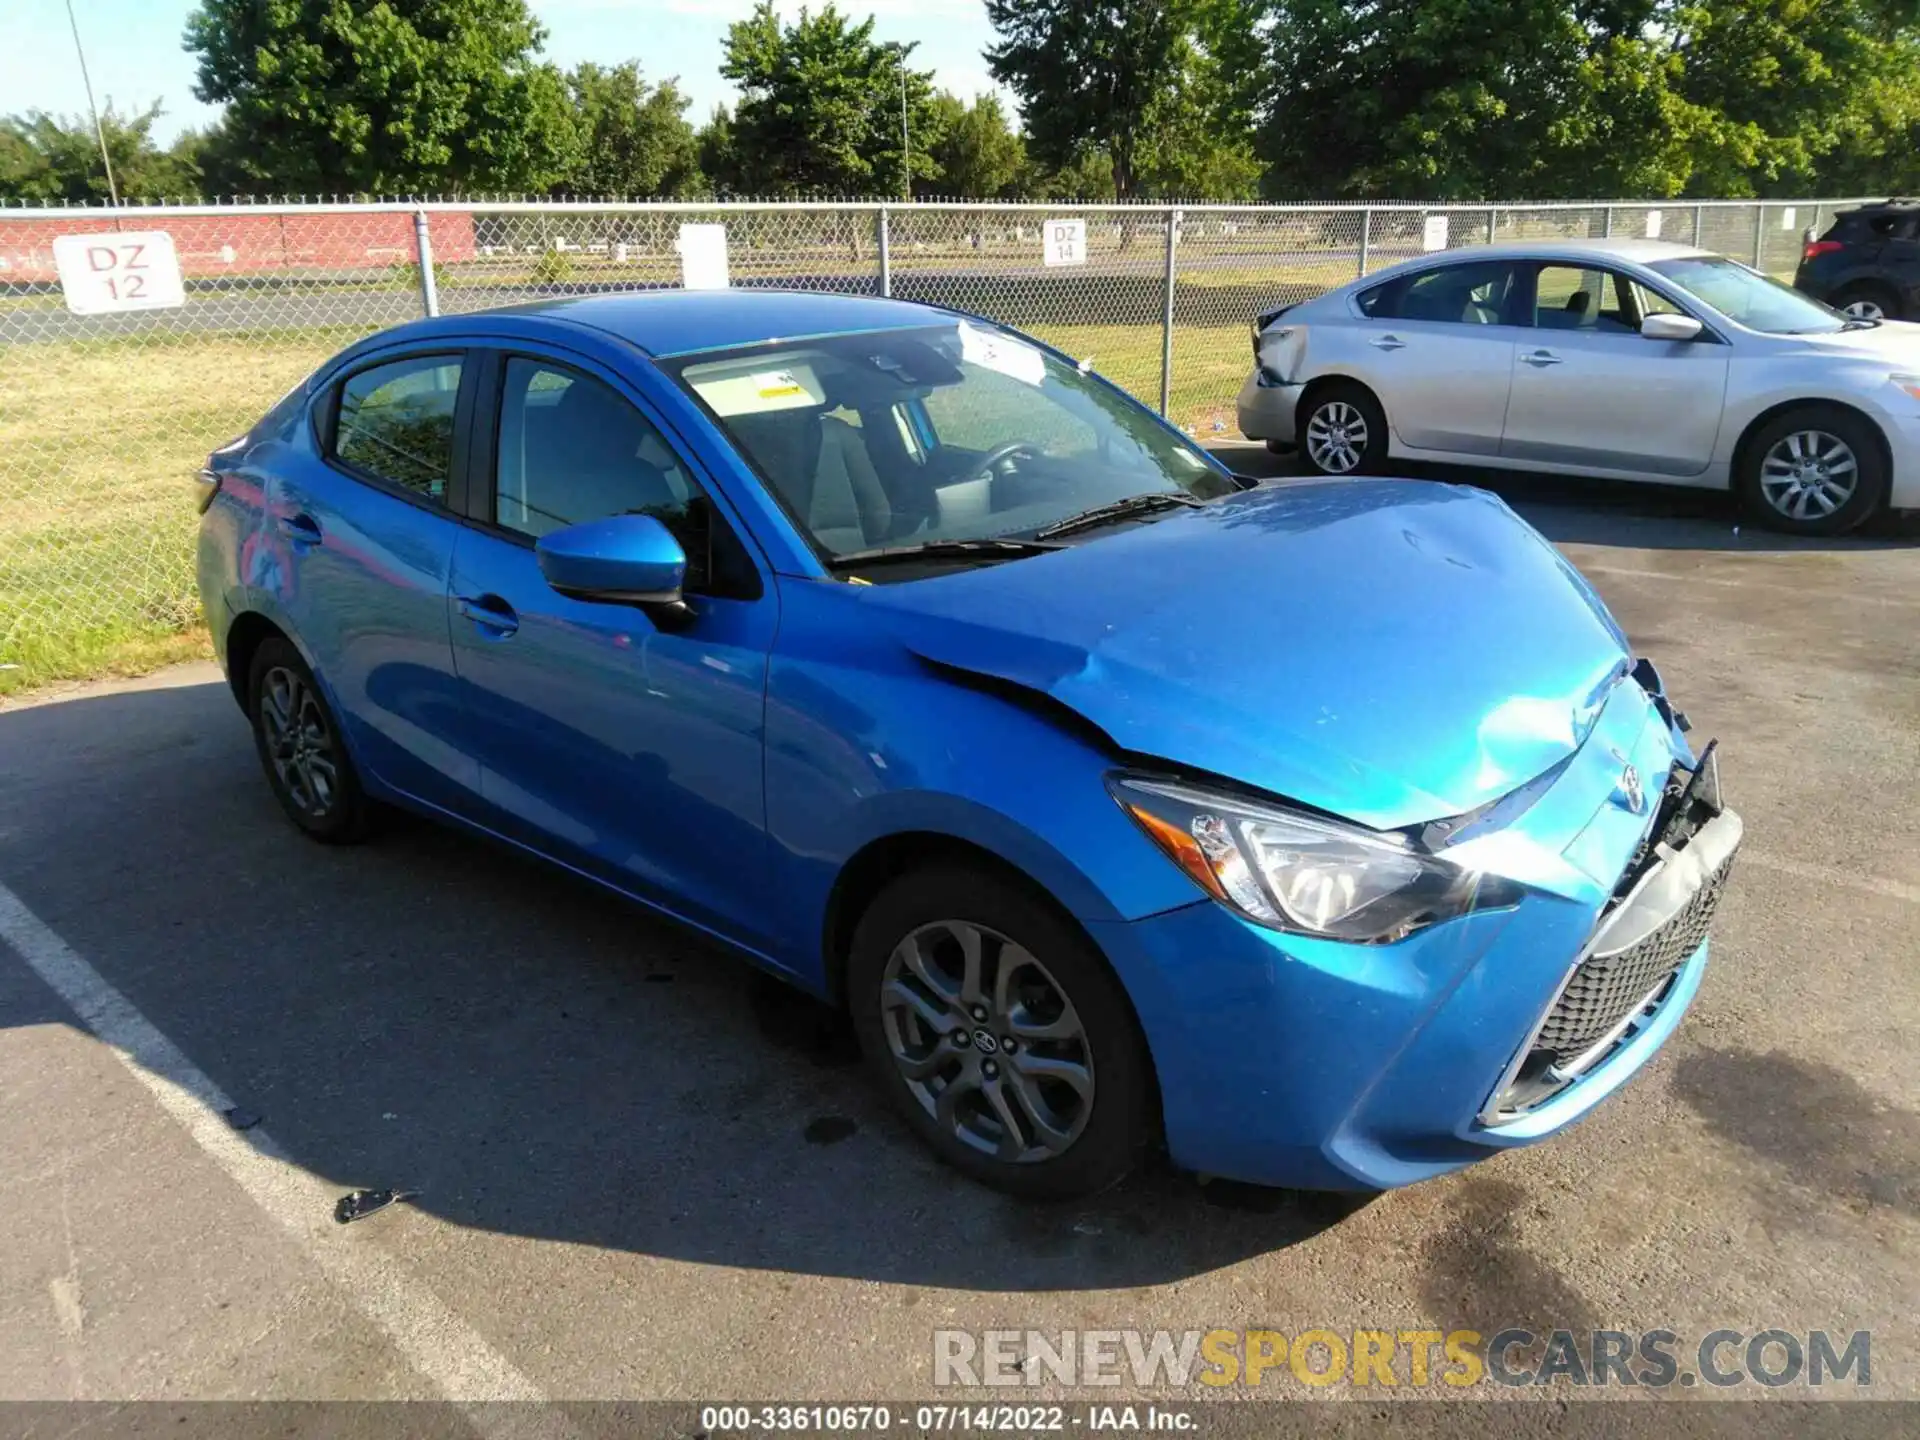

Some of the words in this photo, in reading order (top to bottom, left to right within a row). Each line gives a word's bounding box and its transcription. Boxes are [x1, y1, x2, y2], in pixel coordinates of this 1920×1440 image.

[1055, 226, 1077, 242] DZ
[87, 244, 149, 272] DZ
[1058, 244, 1073, 260] 14
[104, 274, 148, 300] 12
